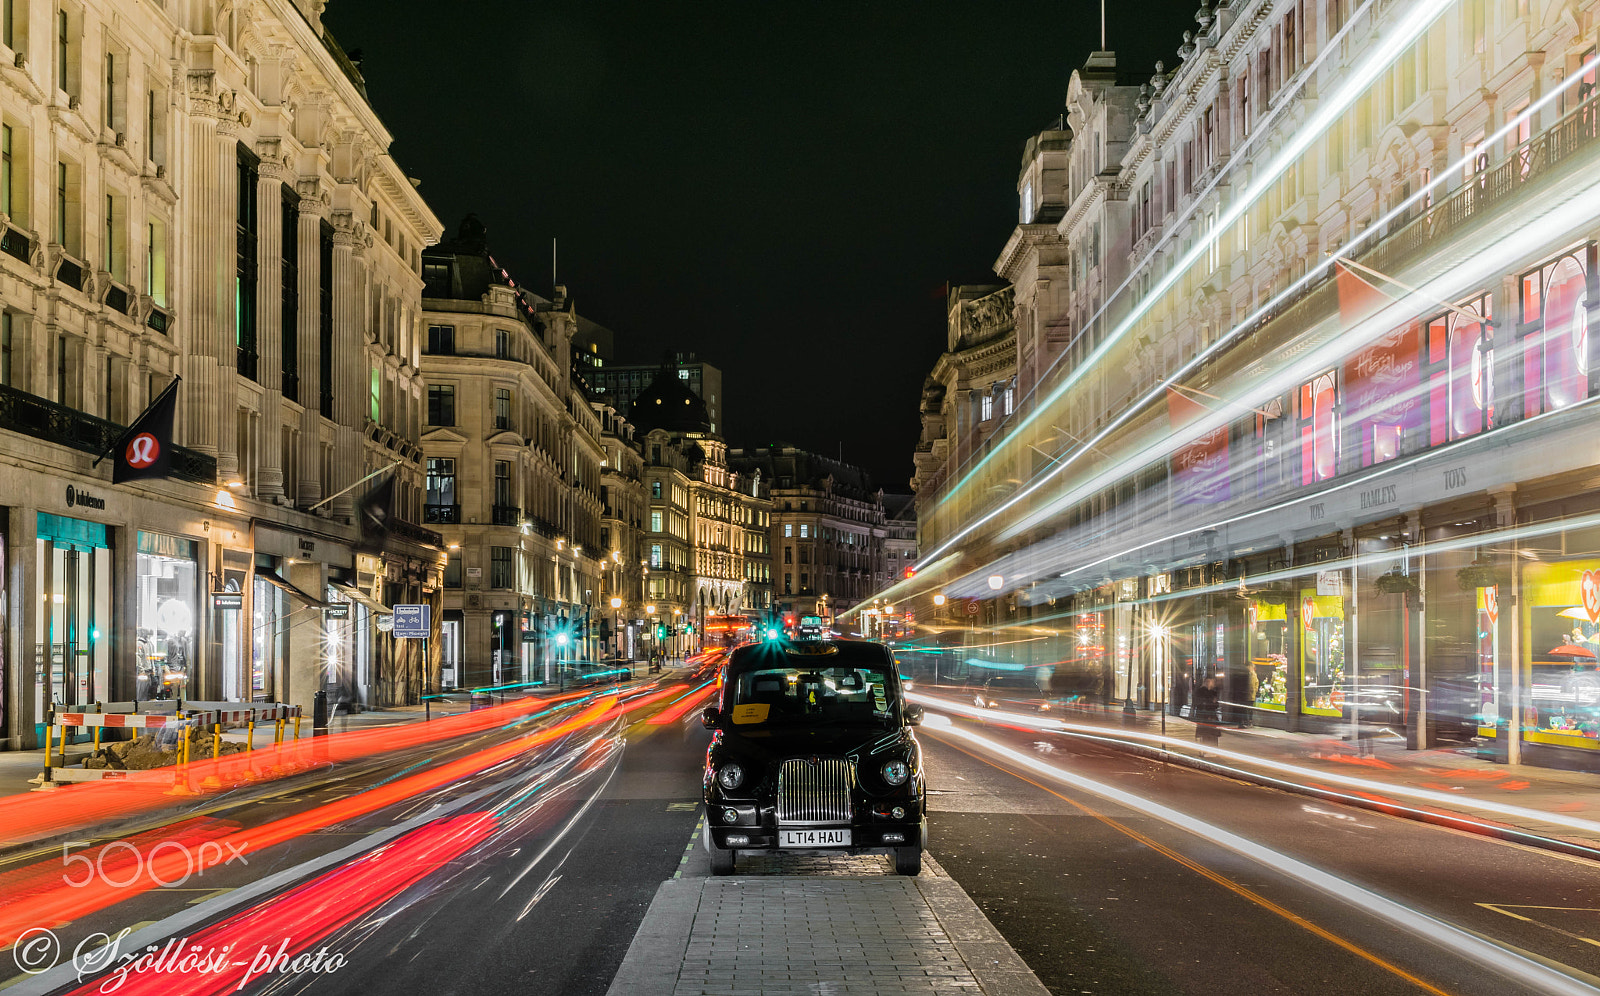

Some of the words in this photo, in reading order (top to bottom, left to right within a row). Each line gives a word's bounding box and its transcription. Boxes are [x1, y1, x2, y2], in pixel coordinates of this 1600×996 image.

[1443, 467, 1467, 491] TOYS
[1360, 485, 1396, 510] HAMLEYS
[1309, 503, 1325, 521] TOYS
[787, 832, 815, 844] LT14
[818, 831, 843, 843] HAU
